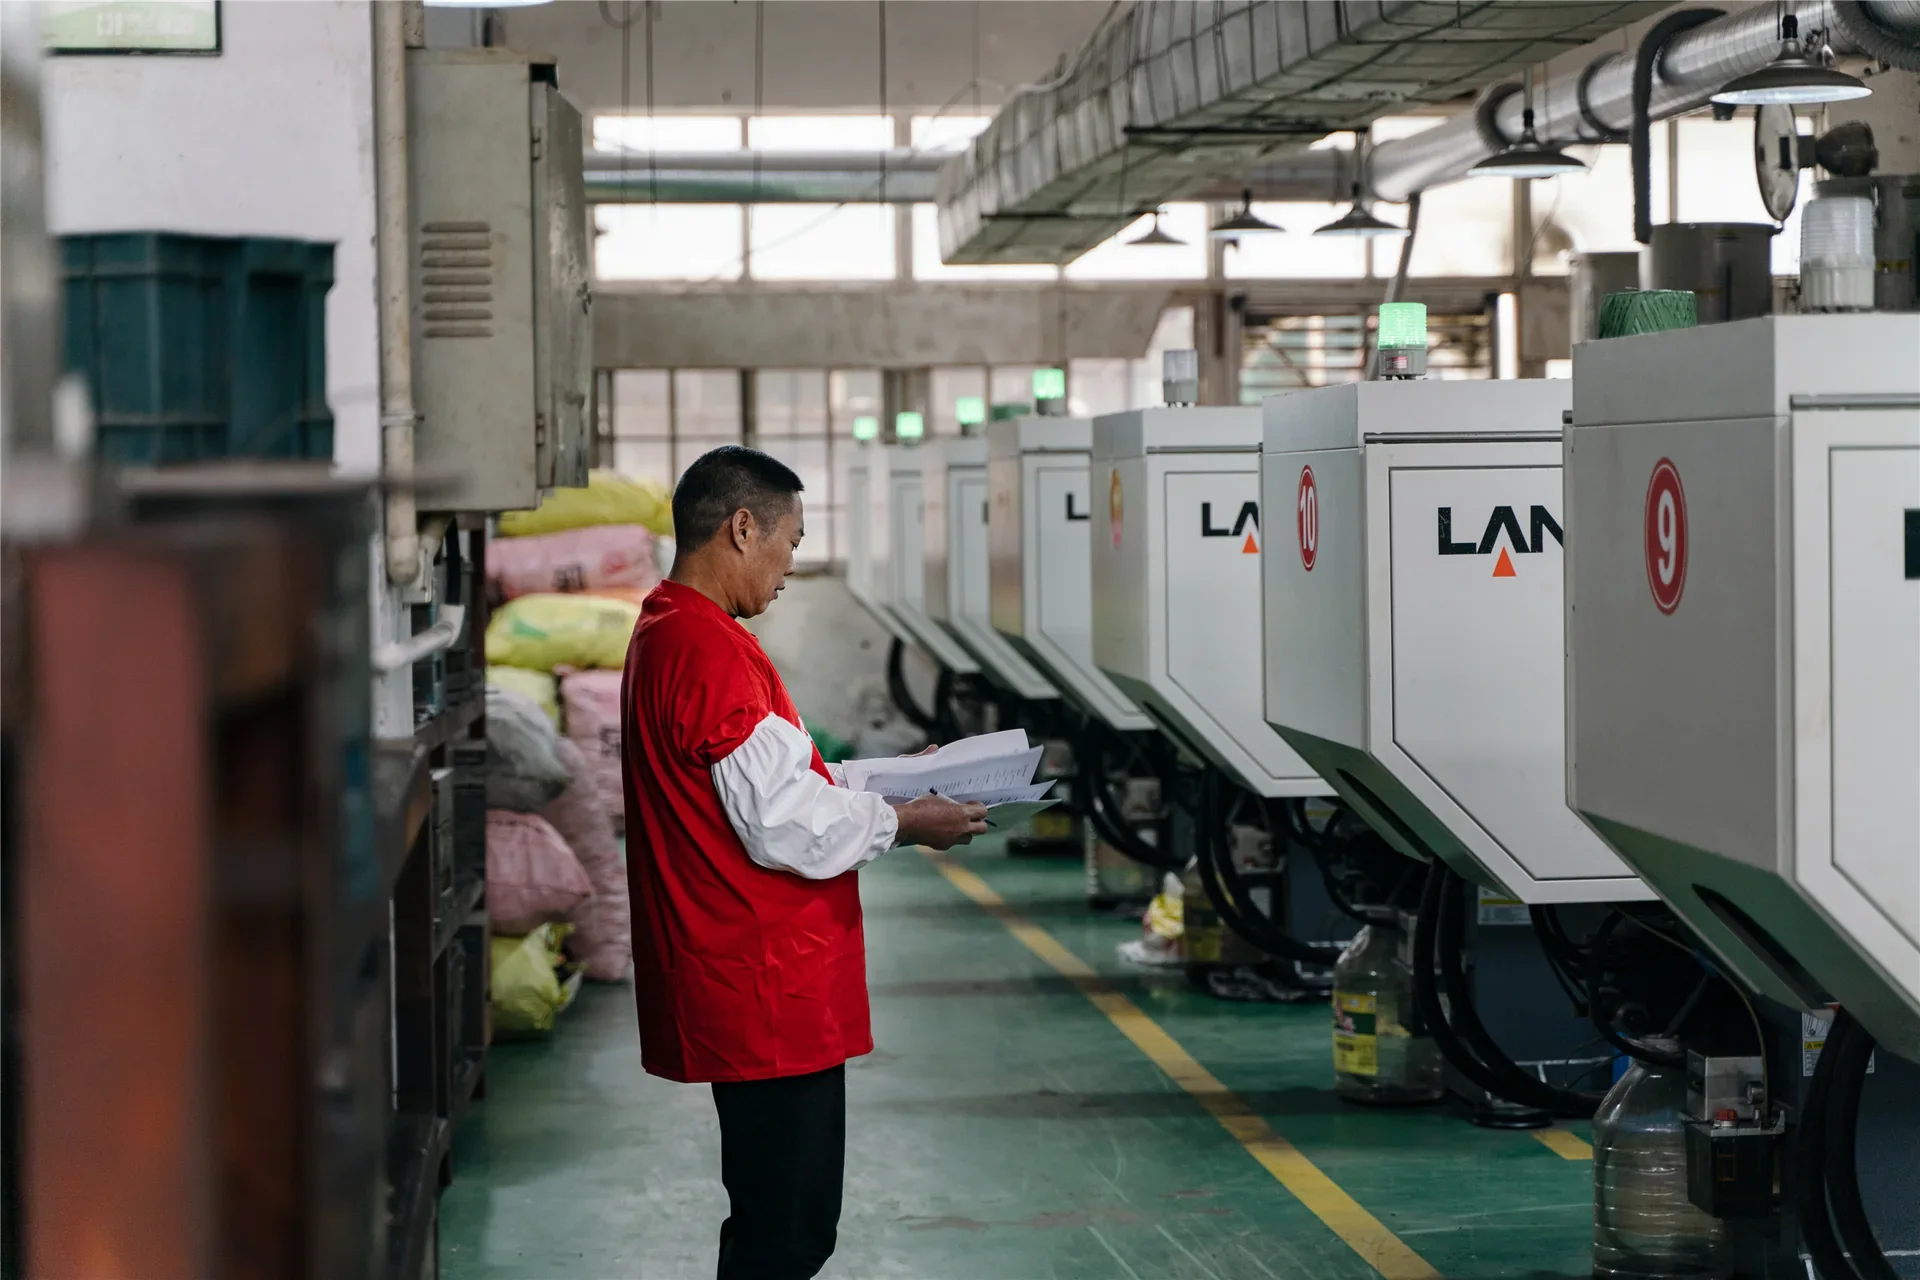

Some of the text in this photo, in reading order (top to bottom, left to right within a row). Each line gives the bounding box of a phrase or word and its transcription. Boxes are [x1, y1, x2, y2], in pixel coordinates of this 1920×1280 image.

[1300, 485, 1316, 551] 10
[1438, 505, 1563, 555] LAN
[1658, 489, 1677, 586] 9
